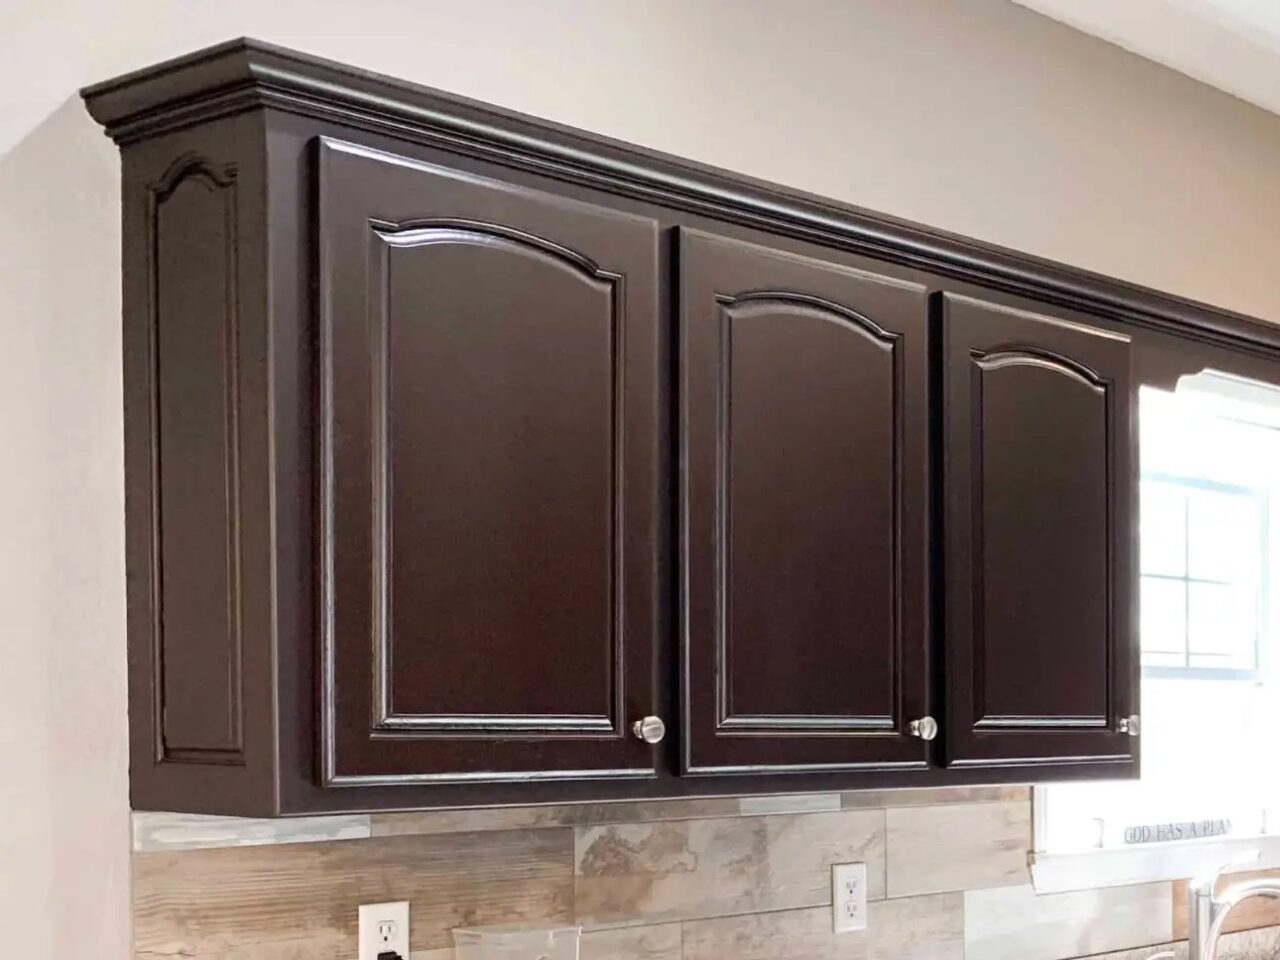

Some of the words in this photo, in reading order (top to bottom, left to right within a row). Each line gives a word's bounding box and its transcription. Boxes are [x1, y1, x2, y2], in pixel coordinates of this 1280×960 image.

[1124, 825, 1151, 843] GOD
[1157, 823, 1183, 841] HAS
[1188, 821, 1198, 838] A
